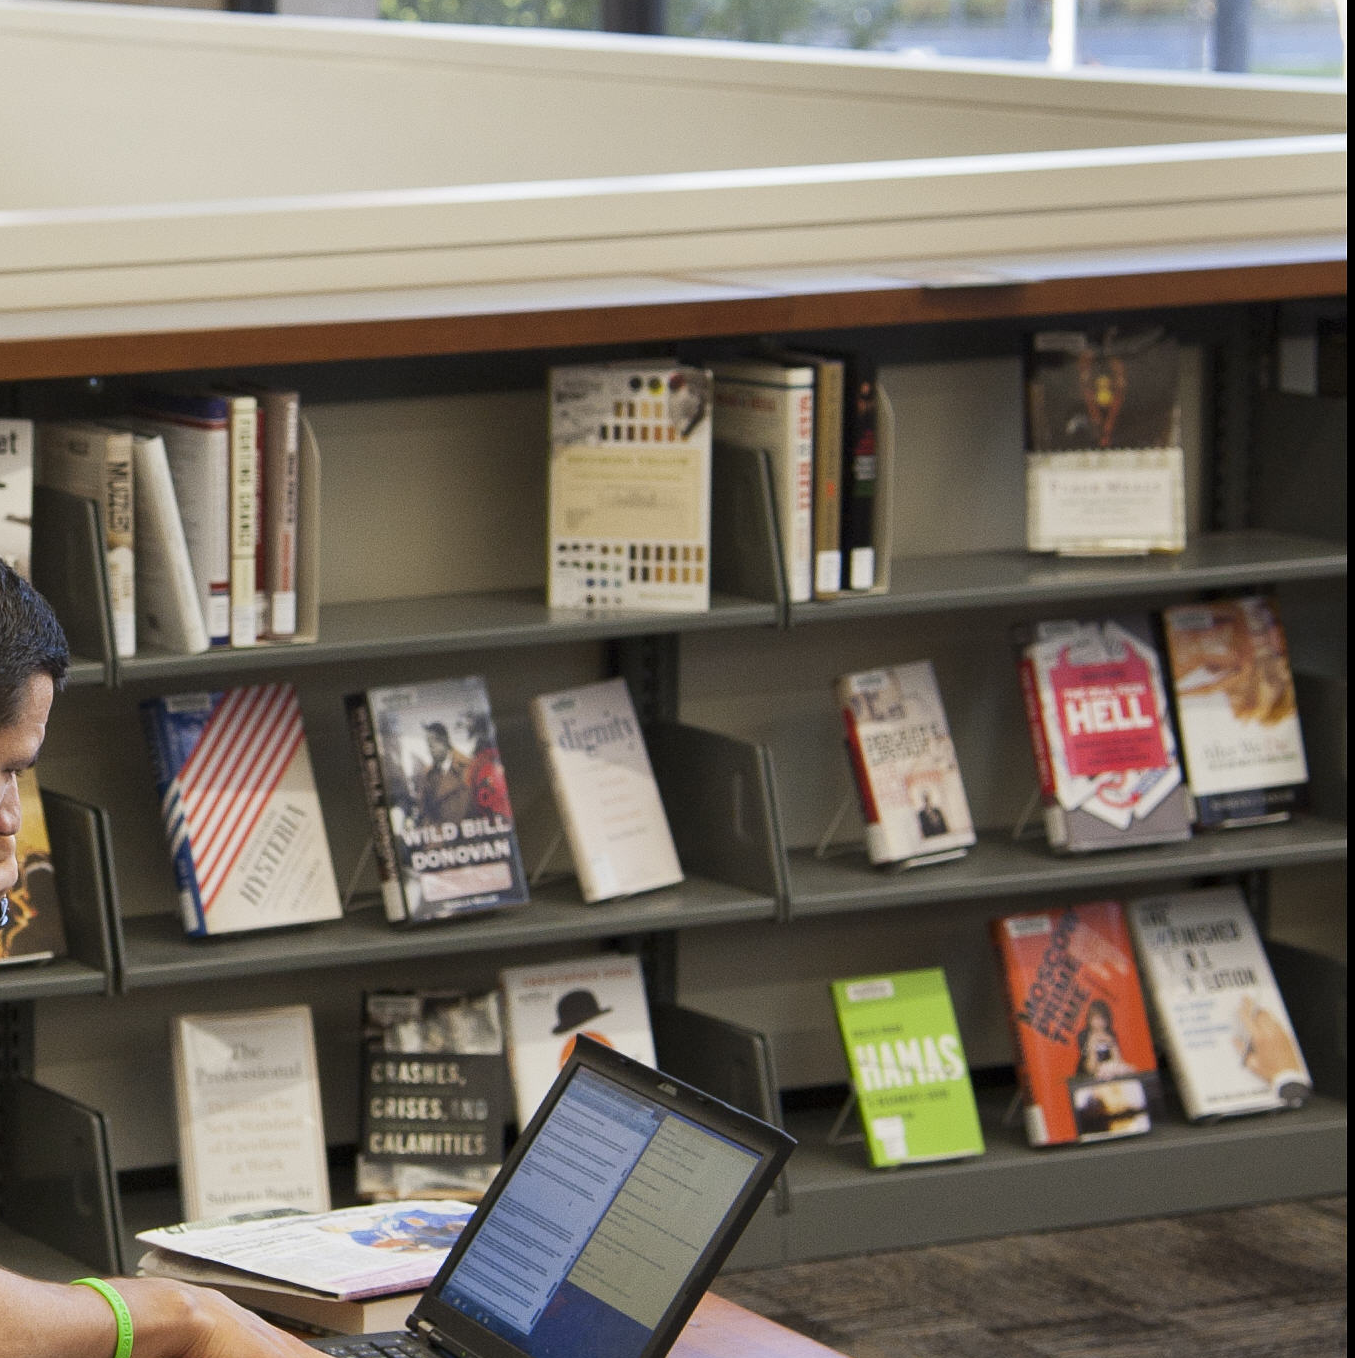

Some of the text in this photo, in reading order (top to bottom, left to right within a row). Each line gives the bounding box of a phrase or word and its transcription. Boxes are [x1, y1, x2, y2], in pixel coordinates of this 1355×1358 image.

[1065, 691, 1153, 737] HELL
[401, 814, 512, 847] WILD BILL
[411, 839, 511, 872] DONOVAN
[232, 1041, 264, 1061] The
[855, 1033, 966, 1092] HAMAS
[370, 1062, 467, 1087] CRASHES,
[369, 1133, 485, 1155] CALAMITIES
